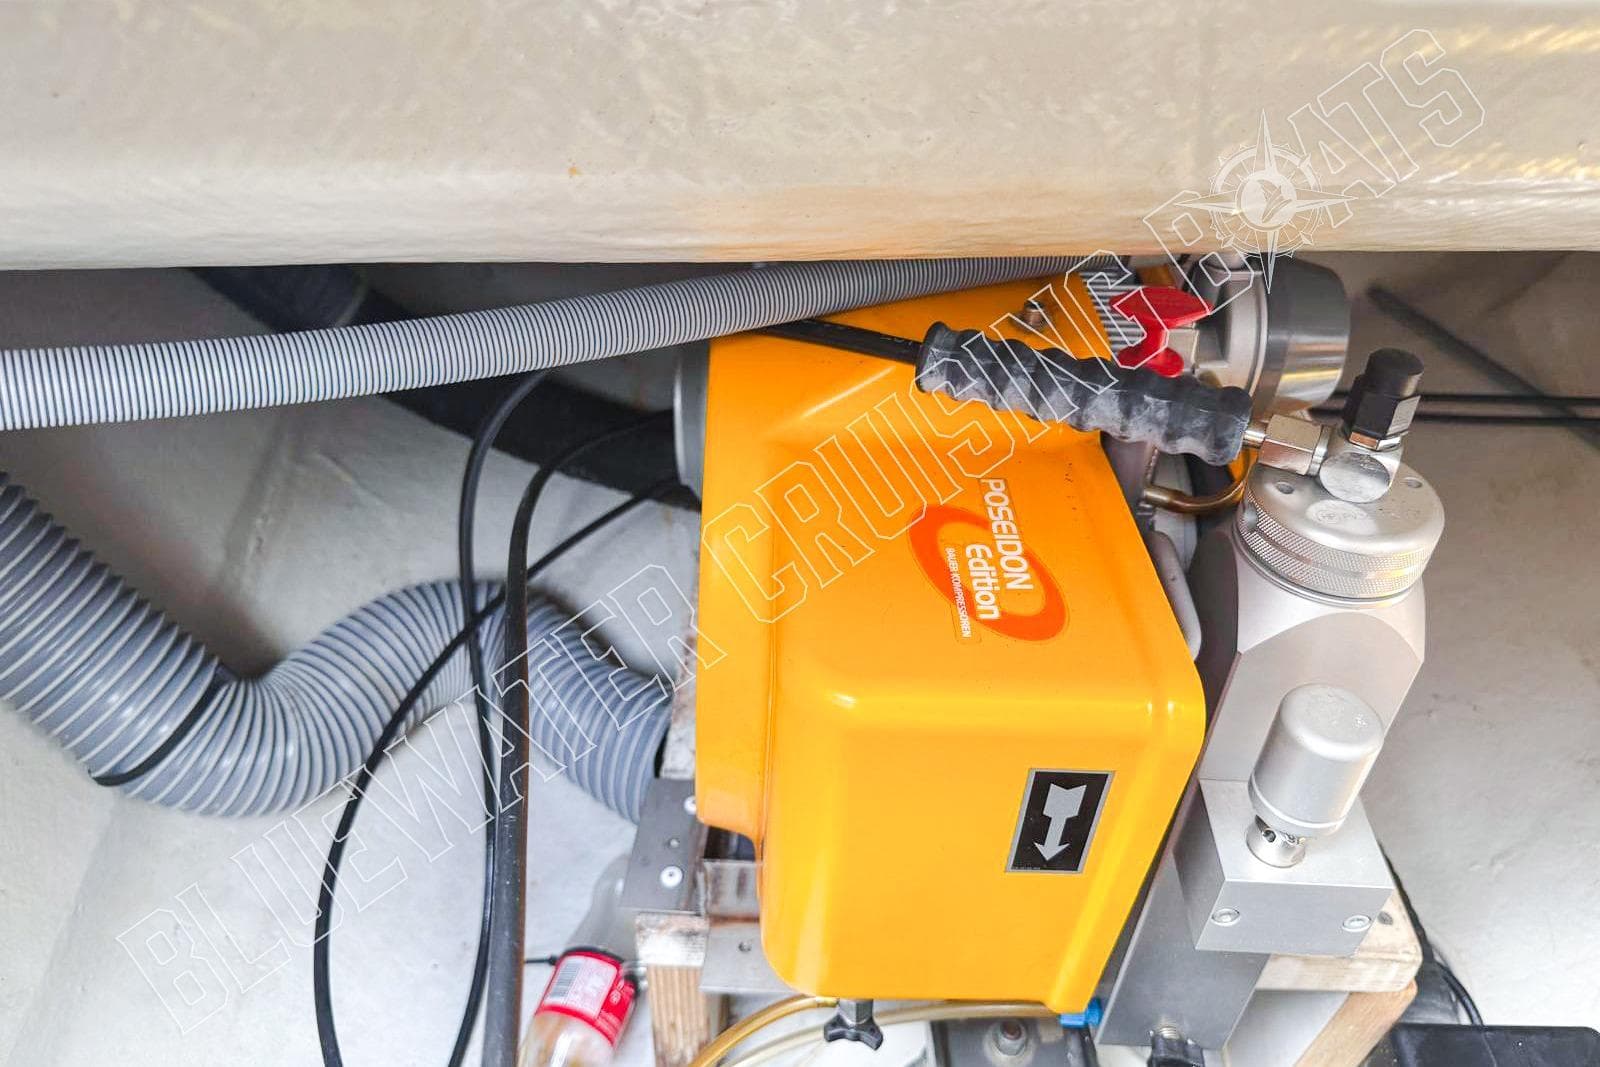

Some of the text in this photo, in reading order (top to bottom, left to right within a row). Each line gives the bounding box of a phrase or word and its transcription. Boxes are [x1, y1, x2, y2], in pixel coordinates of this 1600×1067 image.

[980, 478, 1034, 590] POSEIDON
[951, 573, 971, 638] KOMPRESSOREN
[965, 543, 1001, 620] Edition
